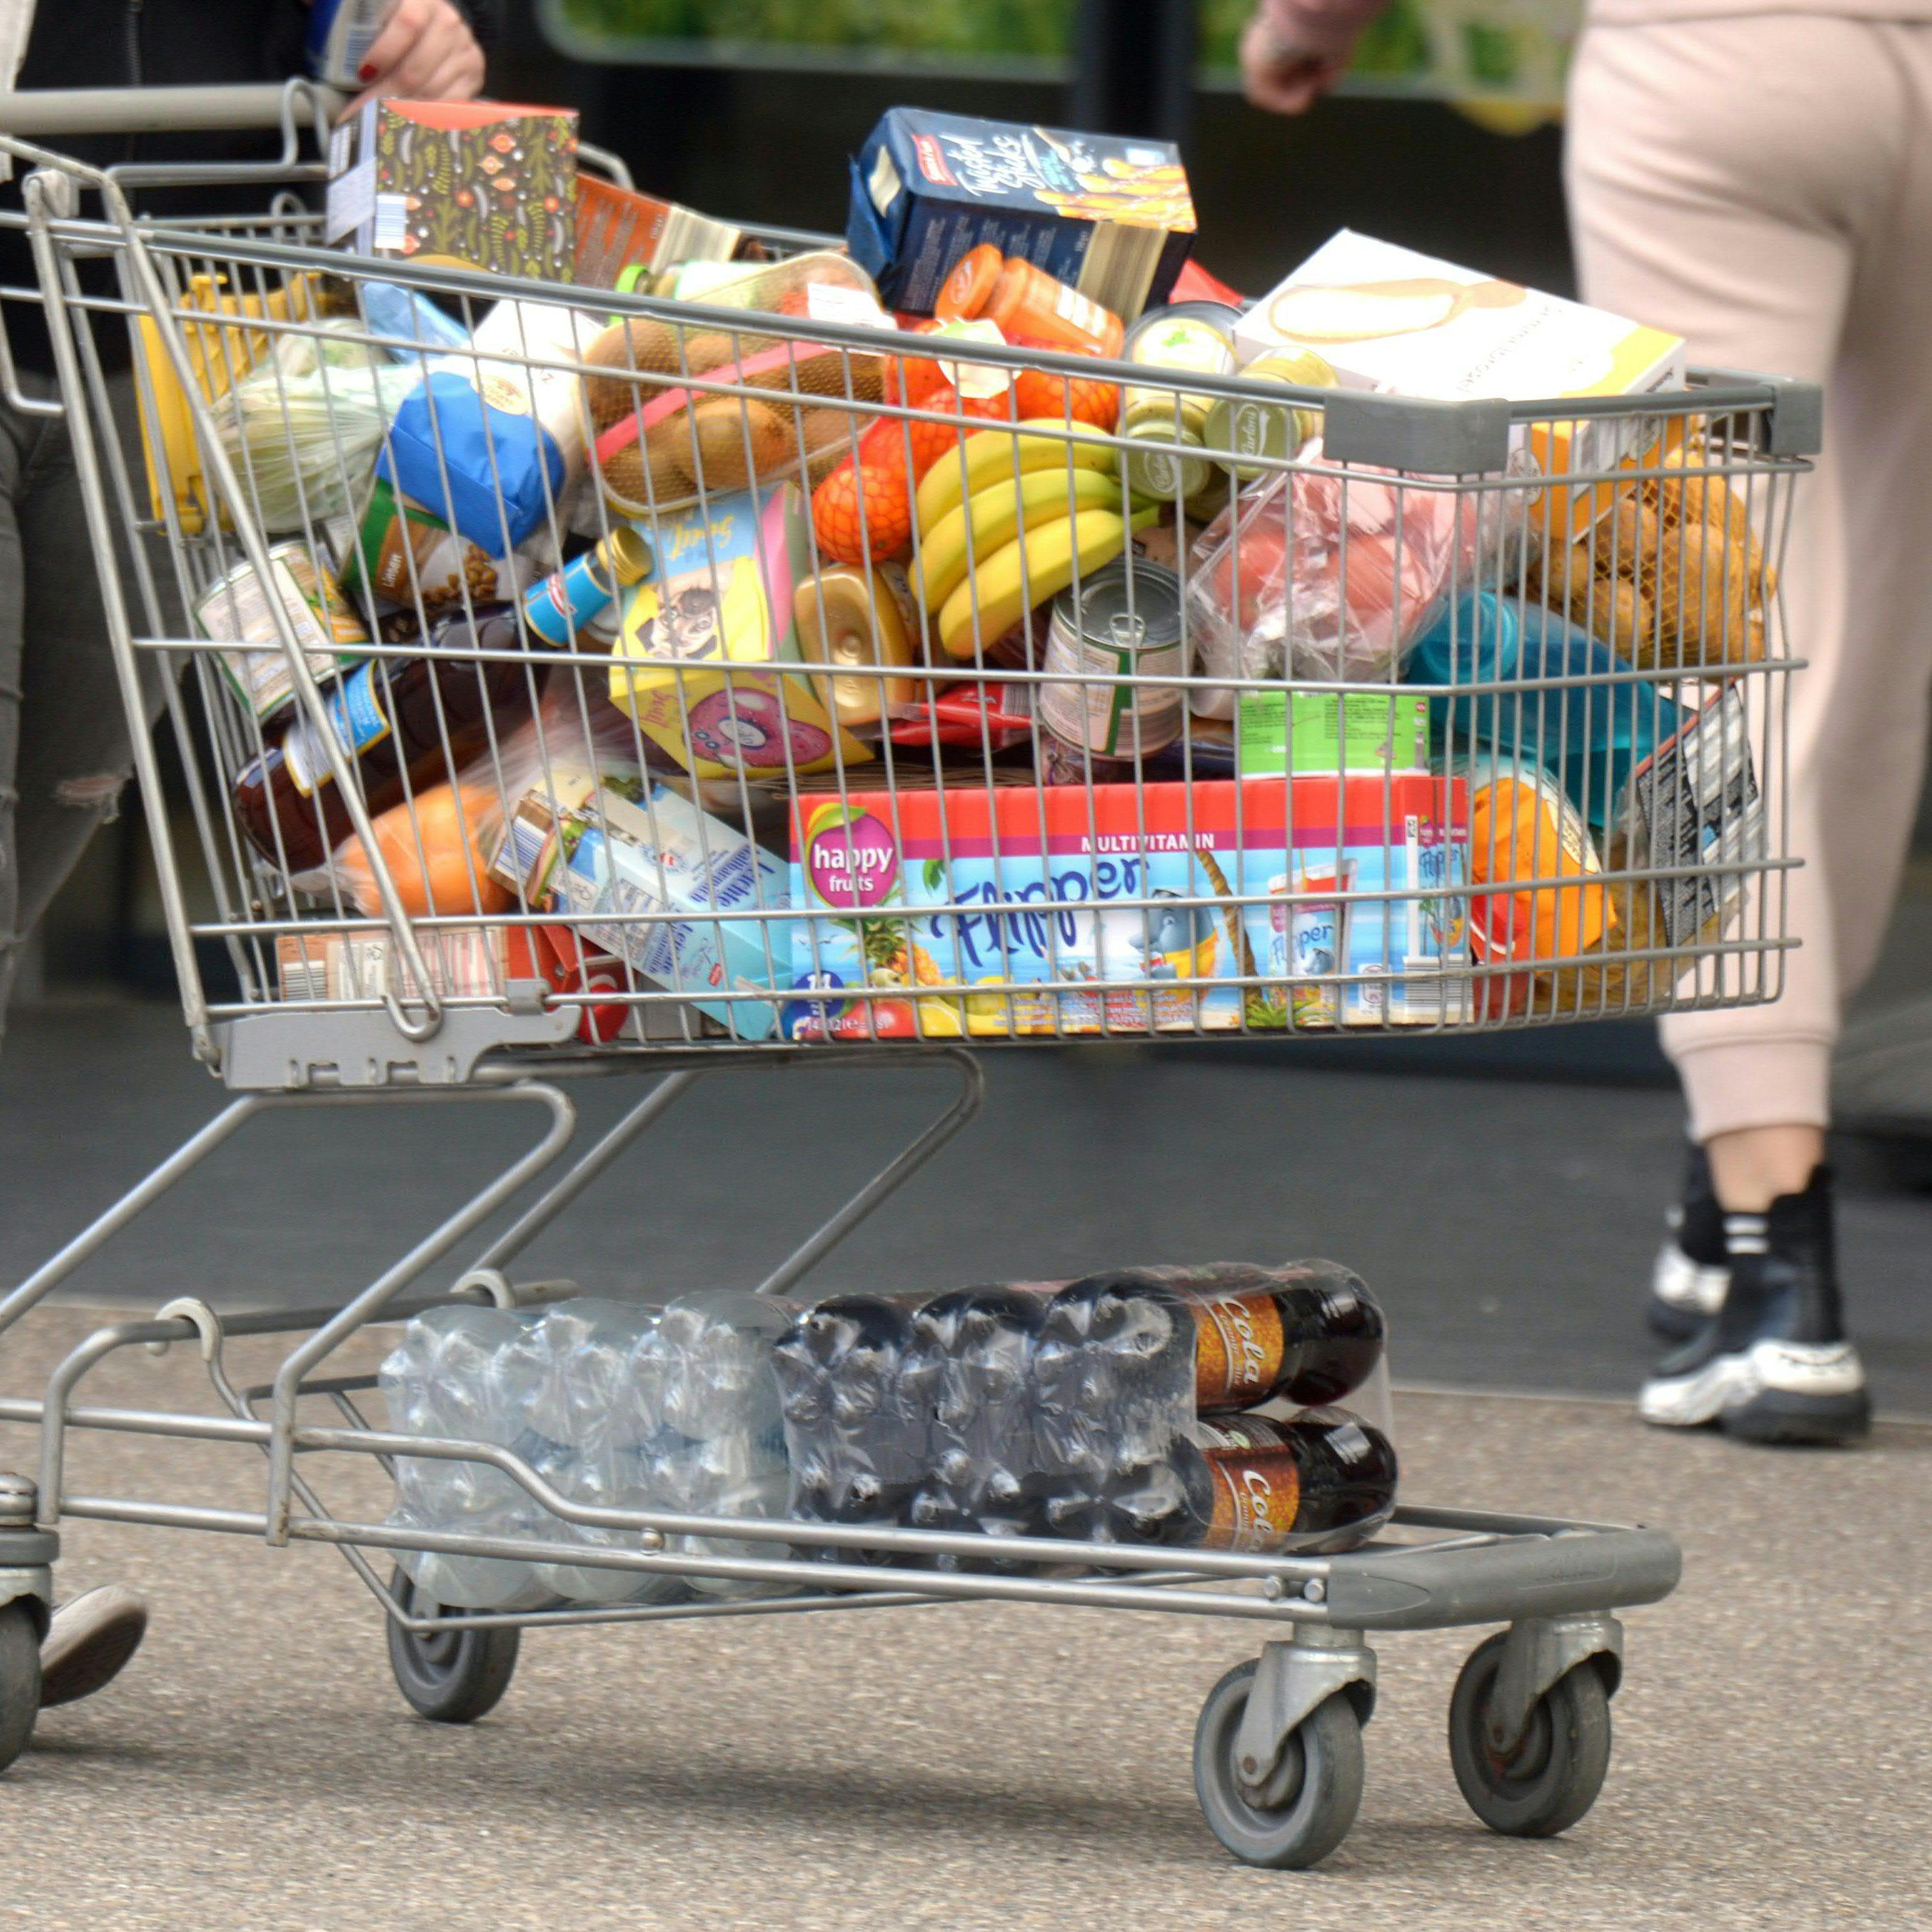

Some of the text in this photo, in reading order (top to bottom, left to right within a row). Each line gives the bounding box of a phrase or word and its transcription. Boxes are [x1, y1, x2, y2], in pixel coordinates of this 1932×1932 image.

[814, 845, 893, 874] happy
[1081, 833, 1215, 852] MULTIITAMIN
[690, 843, 762, 903] altbarmlch
[718, 859, 776, 908] Lichte
[829, 875, 875, 892] fruts
[930, 858, 1150, 968] Flipper
[1219, 1296, 1266, 1385] Cola
